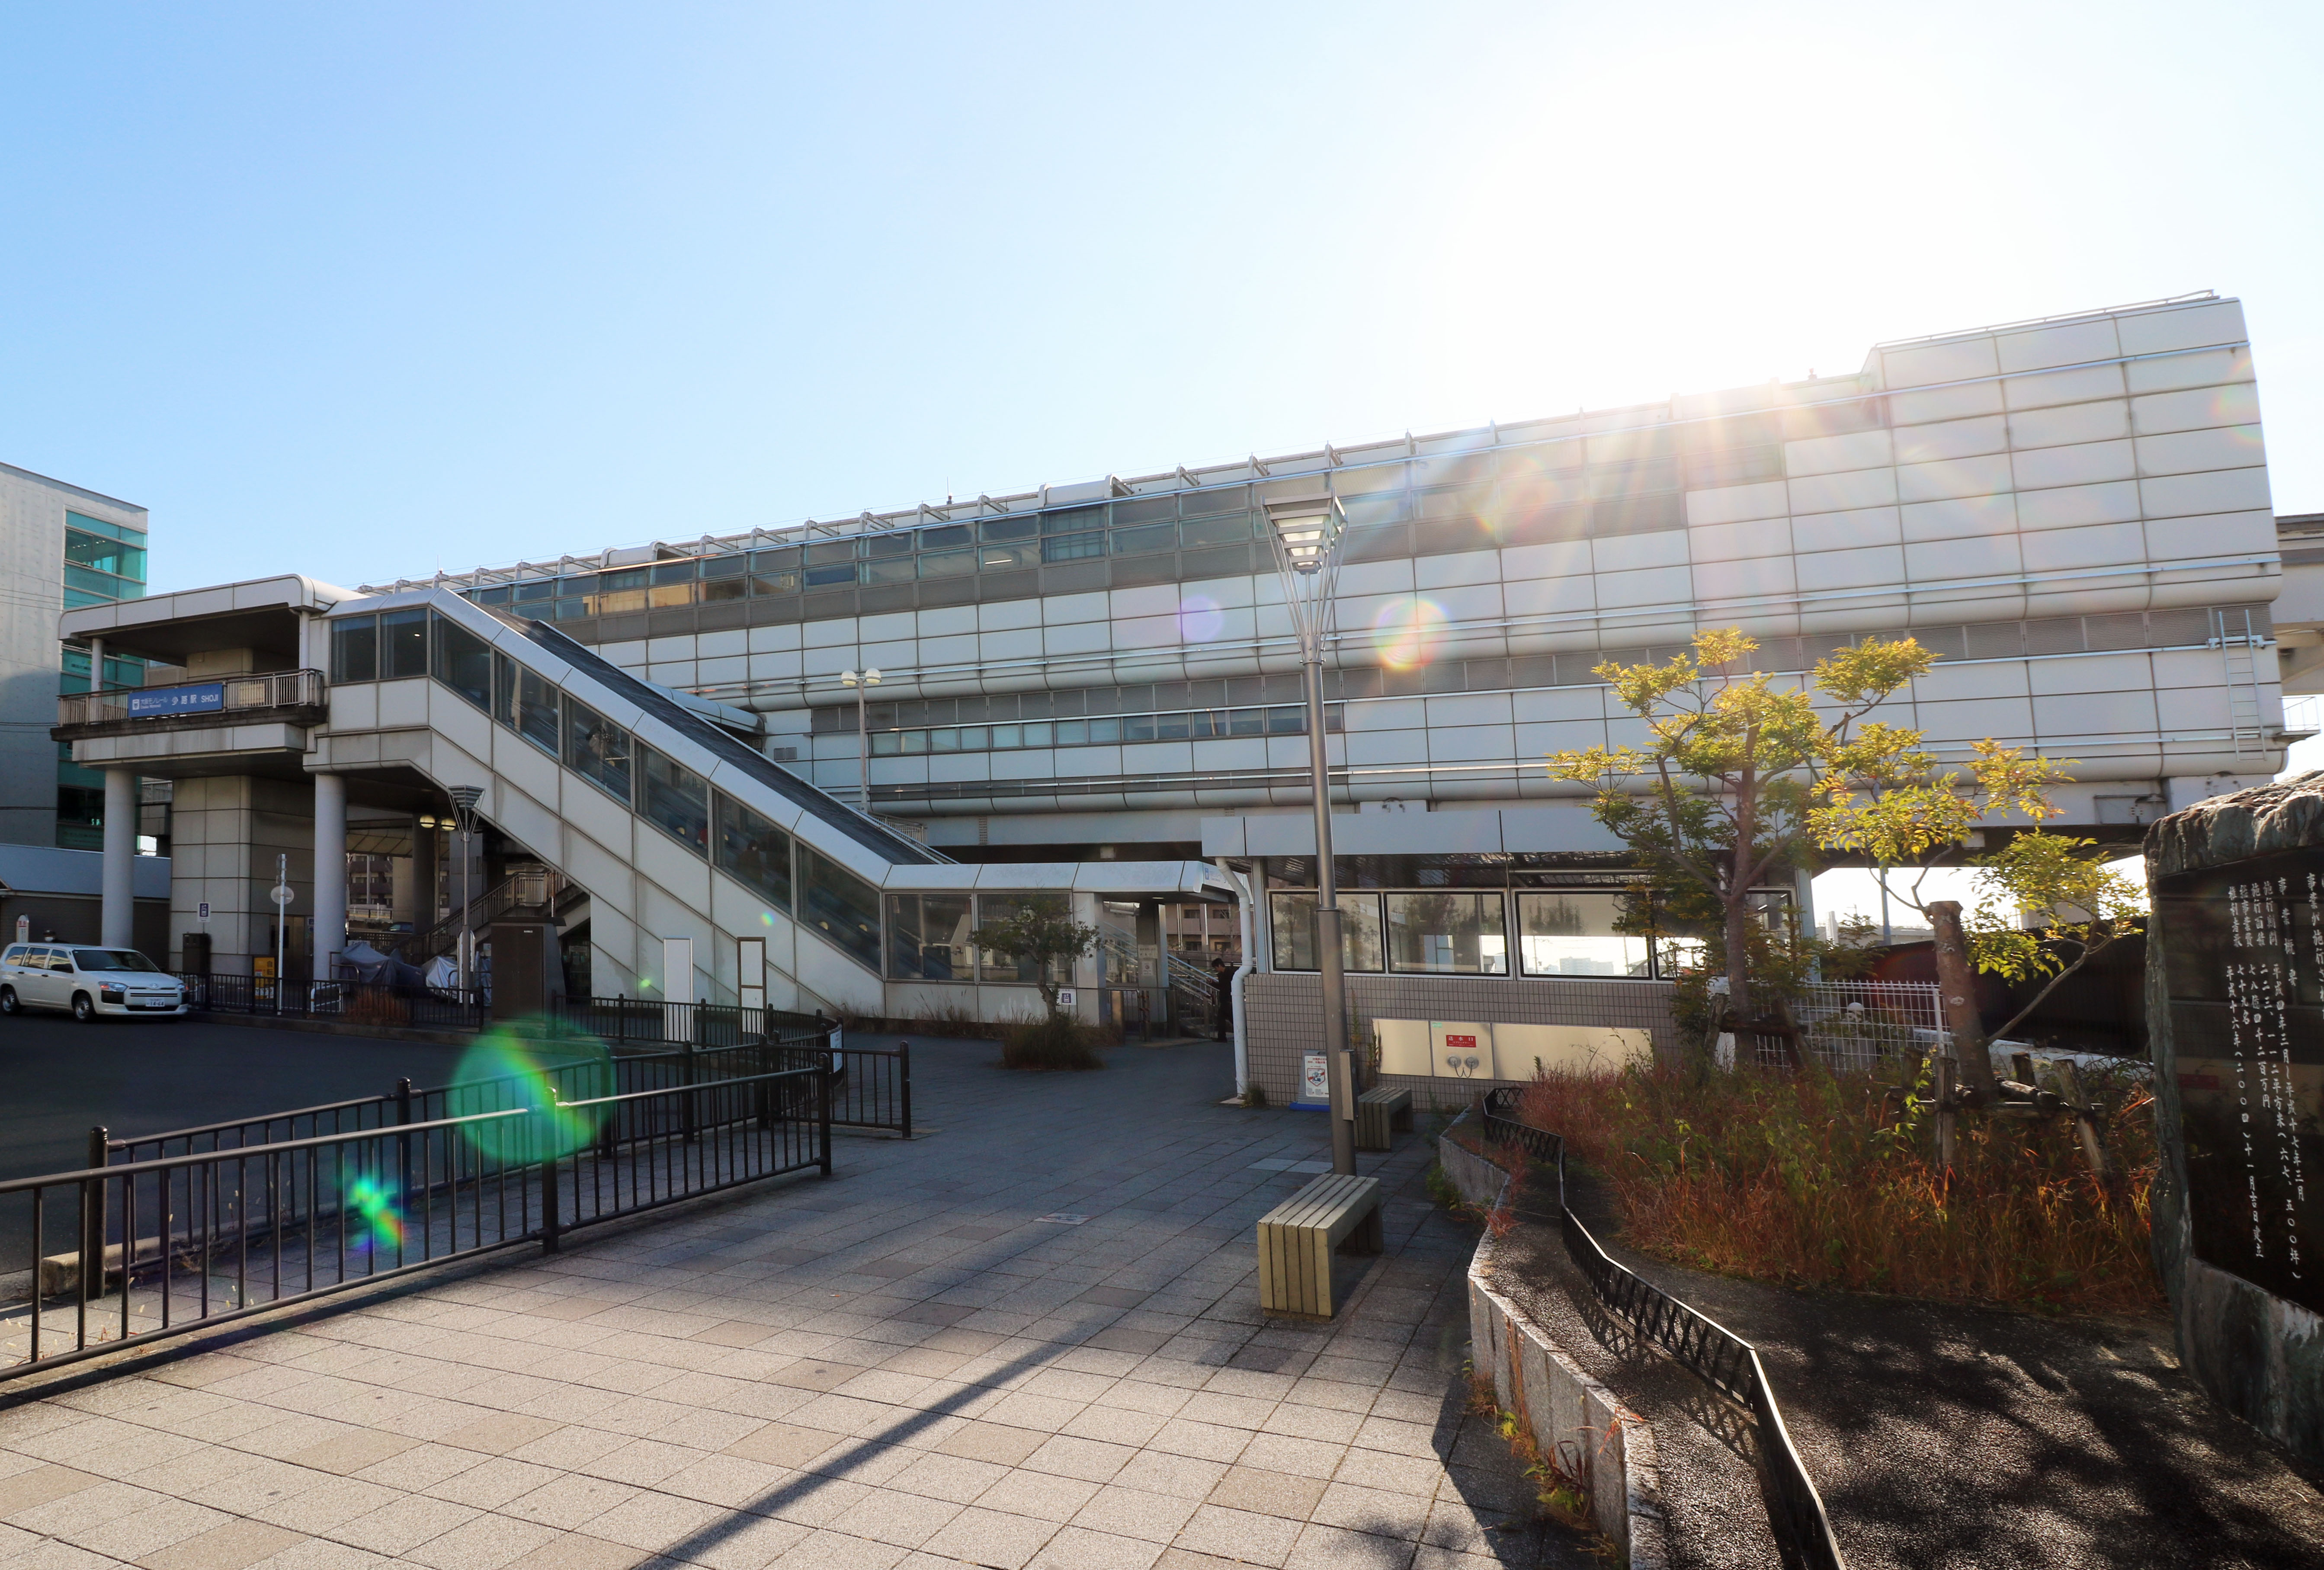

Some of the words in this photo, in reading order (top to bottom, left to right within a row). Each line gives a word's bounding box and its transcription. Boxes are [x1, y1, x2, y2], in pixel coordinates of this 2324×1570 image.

[172, 695, 197, 705] 少路駅
[201, 694, 218, 703] SHOJI
[2237, 964, 2250, 1025] 七十九名
